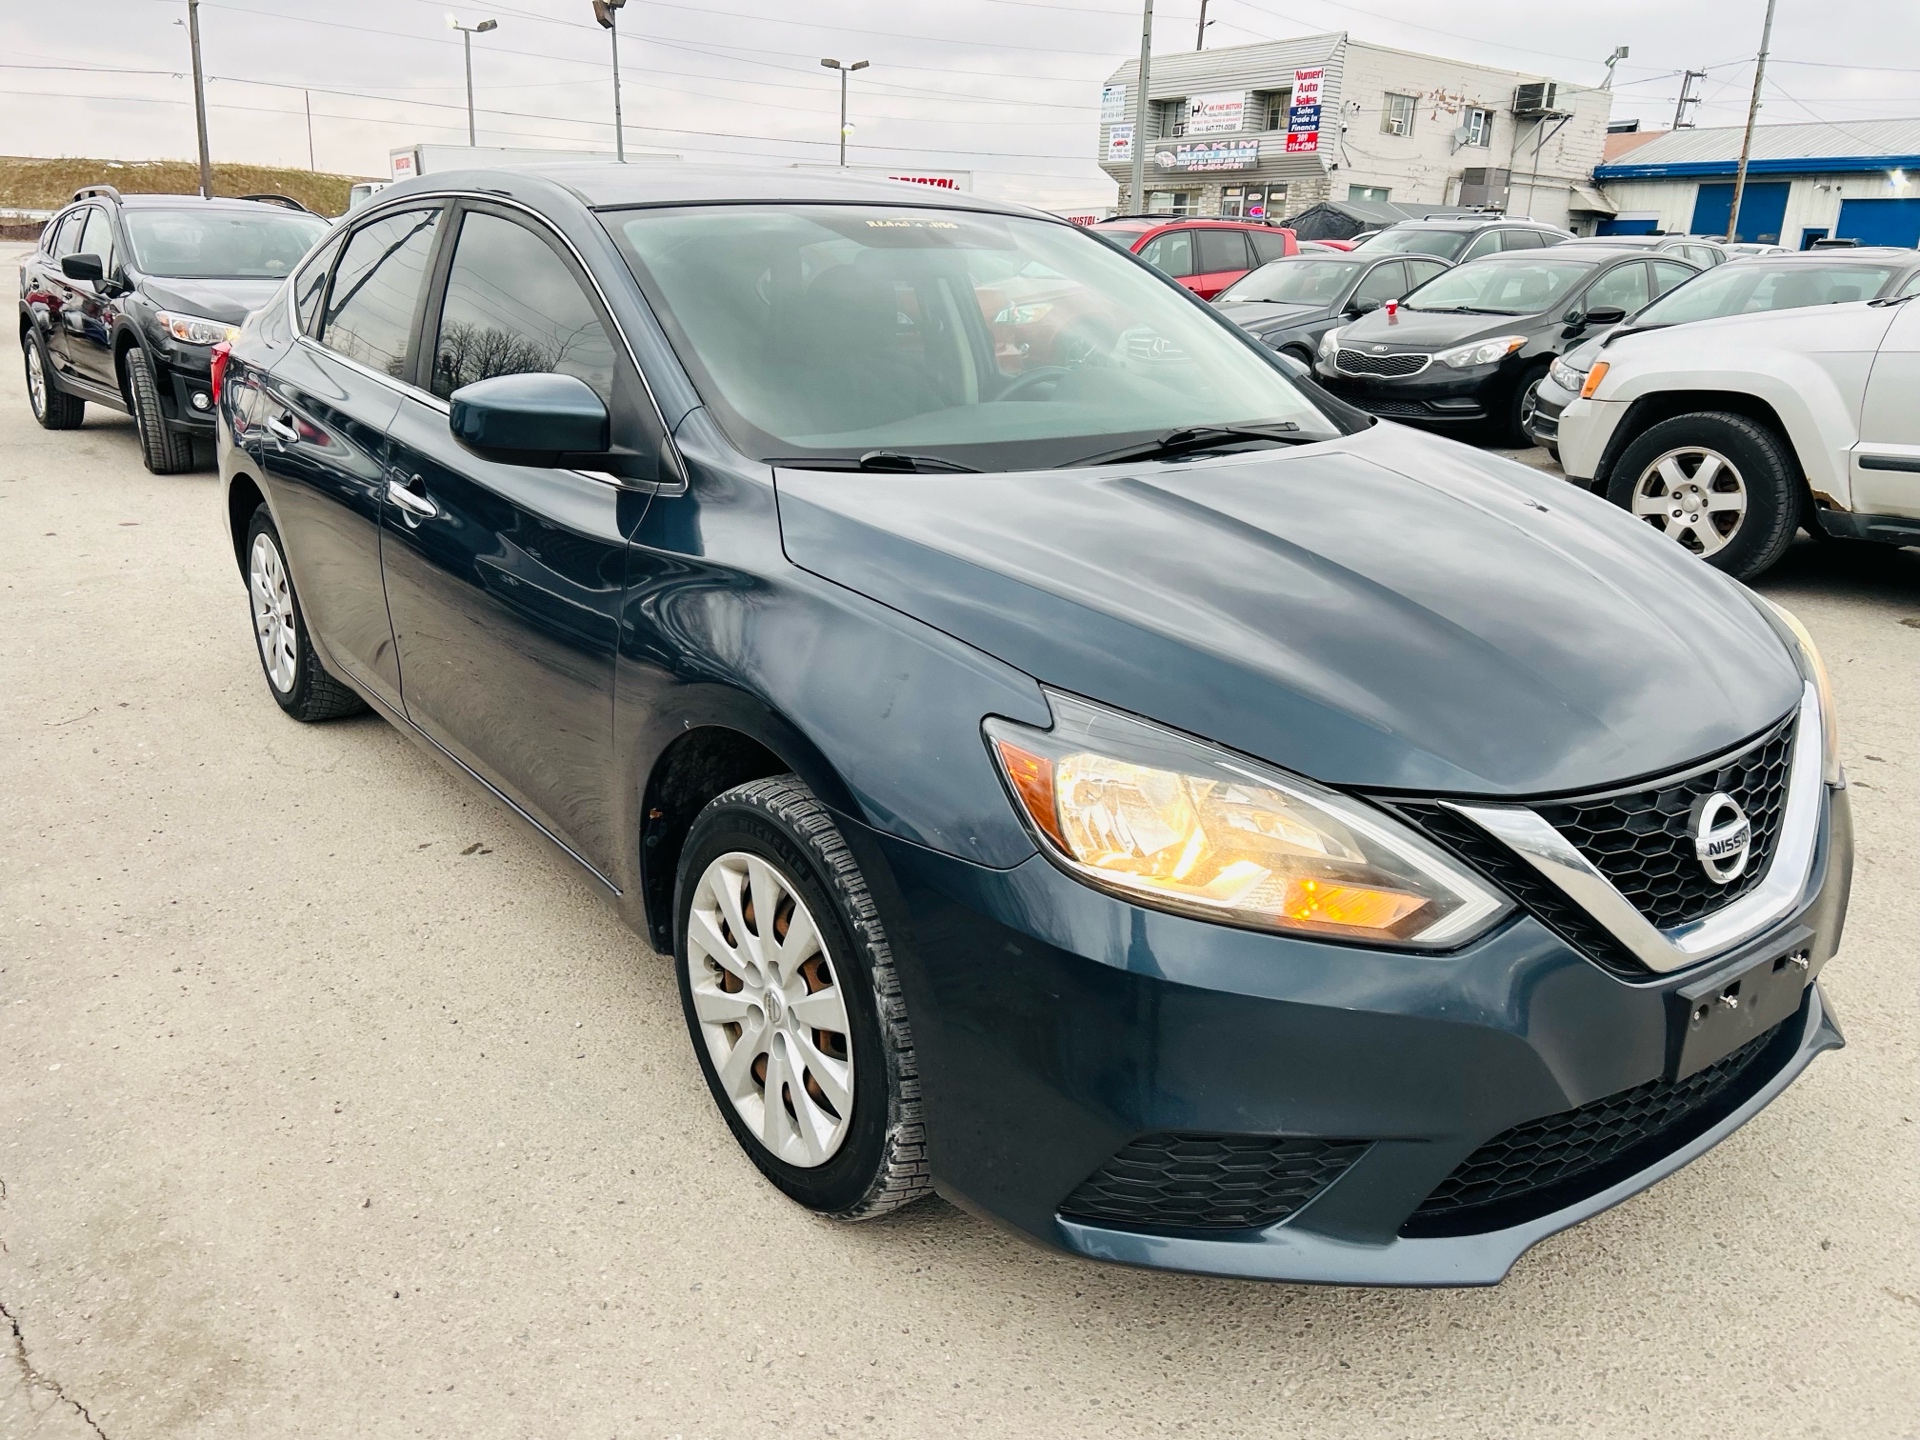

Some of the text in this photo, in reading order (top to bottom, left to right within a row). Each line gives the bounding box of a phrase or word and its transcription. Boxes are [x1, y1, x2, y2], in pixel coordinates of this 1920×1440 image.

[1295, 68, 1324, 80] Numeri
[1298, 83, 1318, 93] Auto
[1296, 95, 1317, 106] Sales
[1297, 134, 1308, 142] 289
[1177, 140, 1258, 152] HAKIM
[1178, 152, 1214, 160] AUTO
[738, 819, 807, 877] MICHELIN
